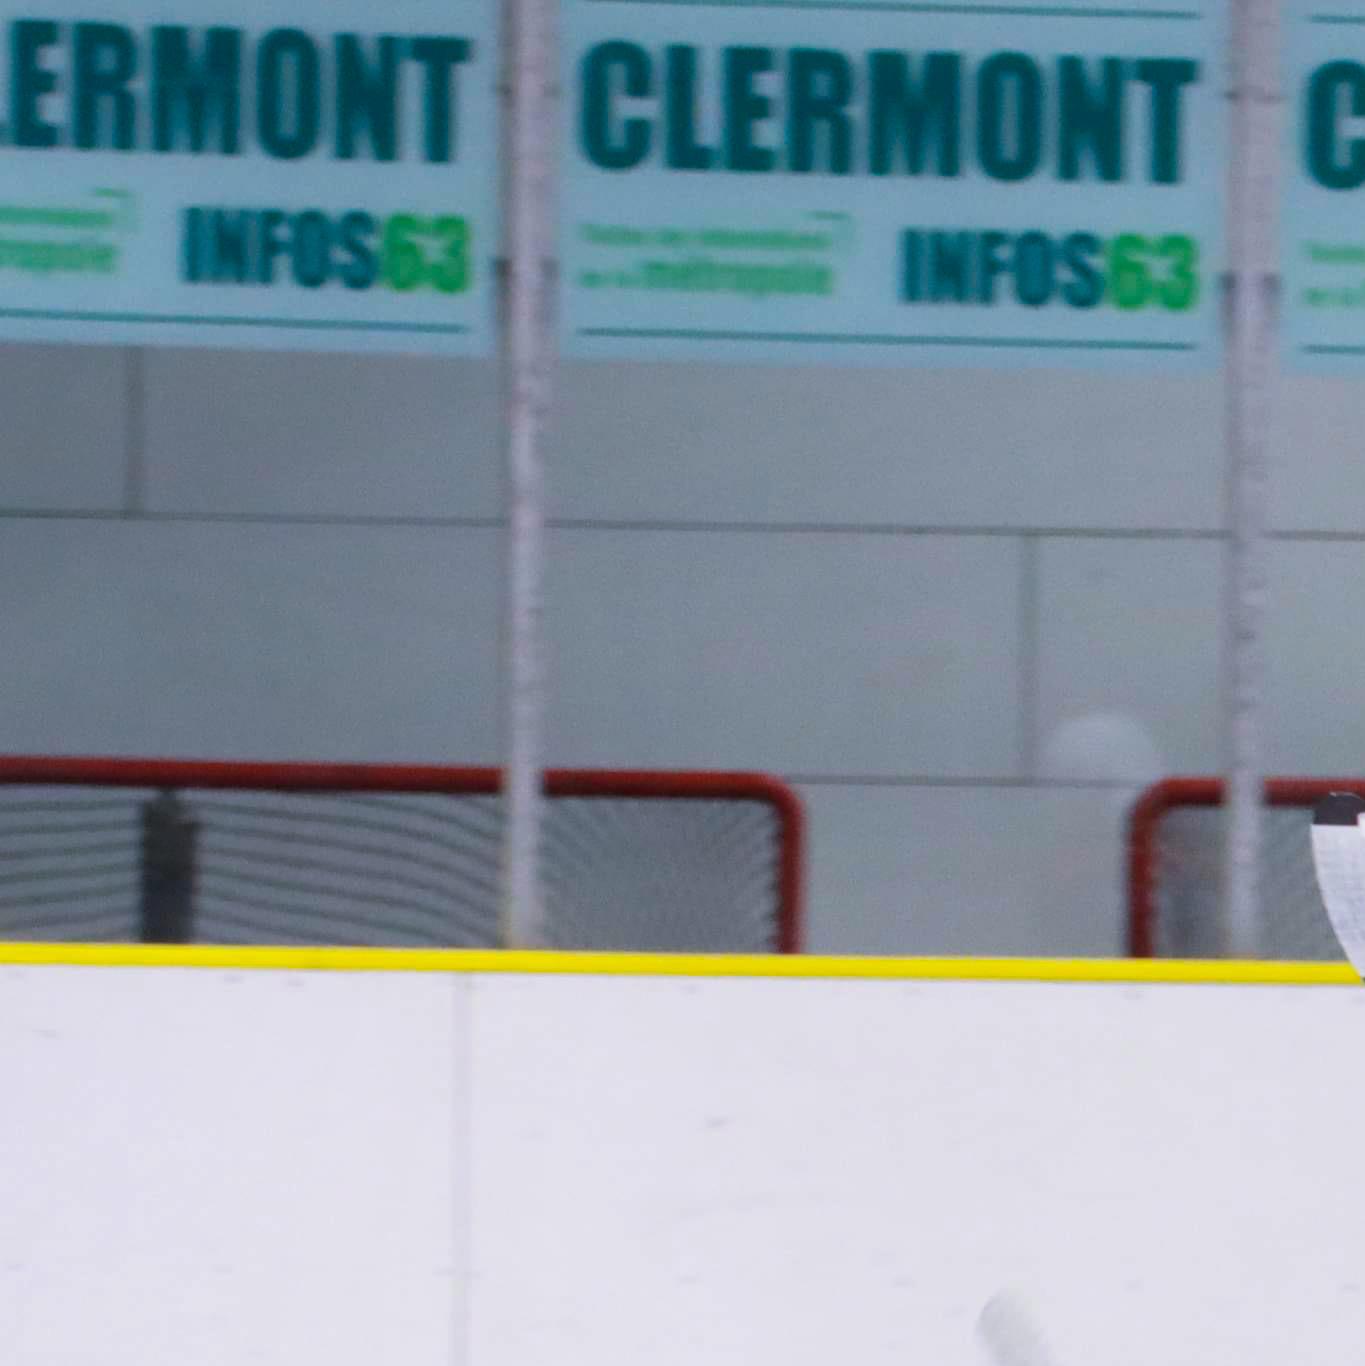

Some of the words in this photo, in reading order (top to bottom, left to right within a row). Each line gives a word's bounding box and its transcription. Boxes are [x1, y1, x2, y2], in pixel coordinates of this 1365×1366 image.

[0, 20, 472, 163] ERMONT
[580, 39, 1201, 185] CLERMONT
[182, 205, 470, 293] INFOS63
[900, 227, 1196, 310] INFOS63
